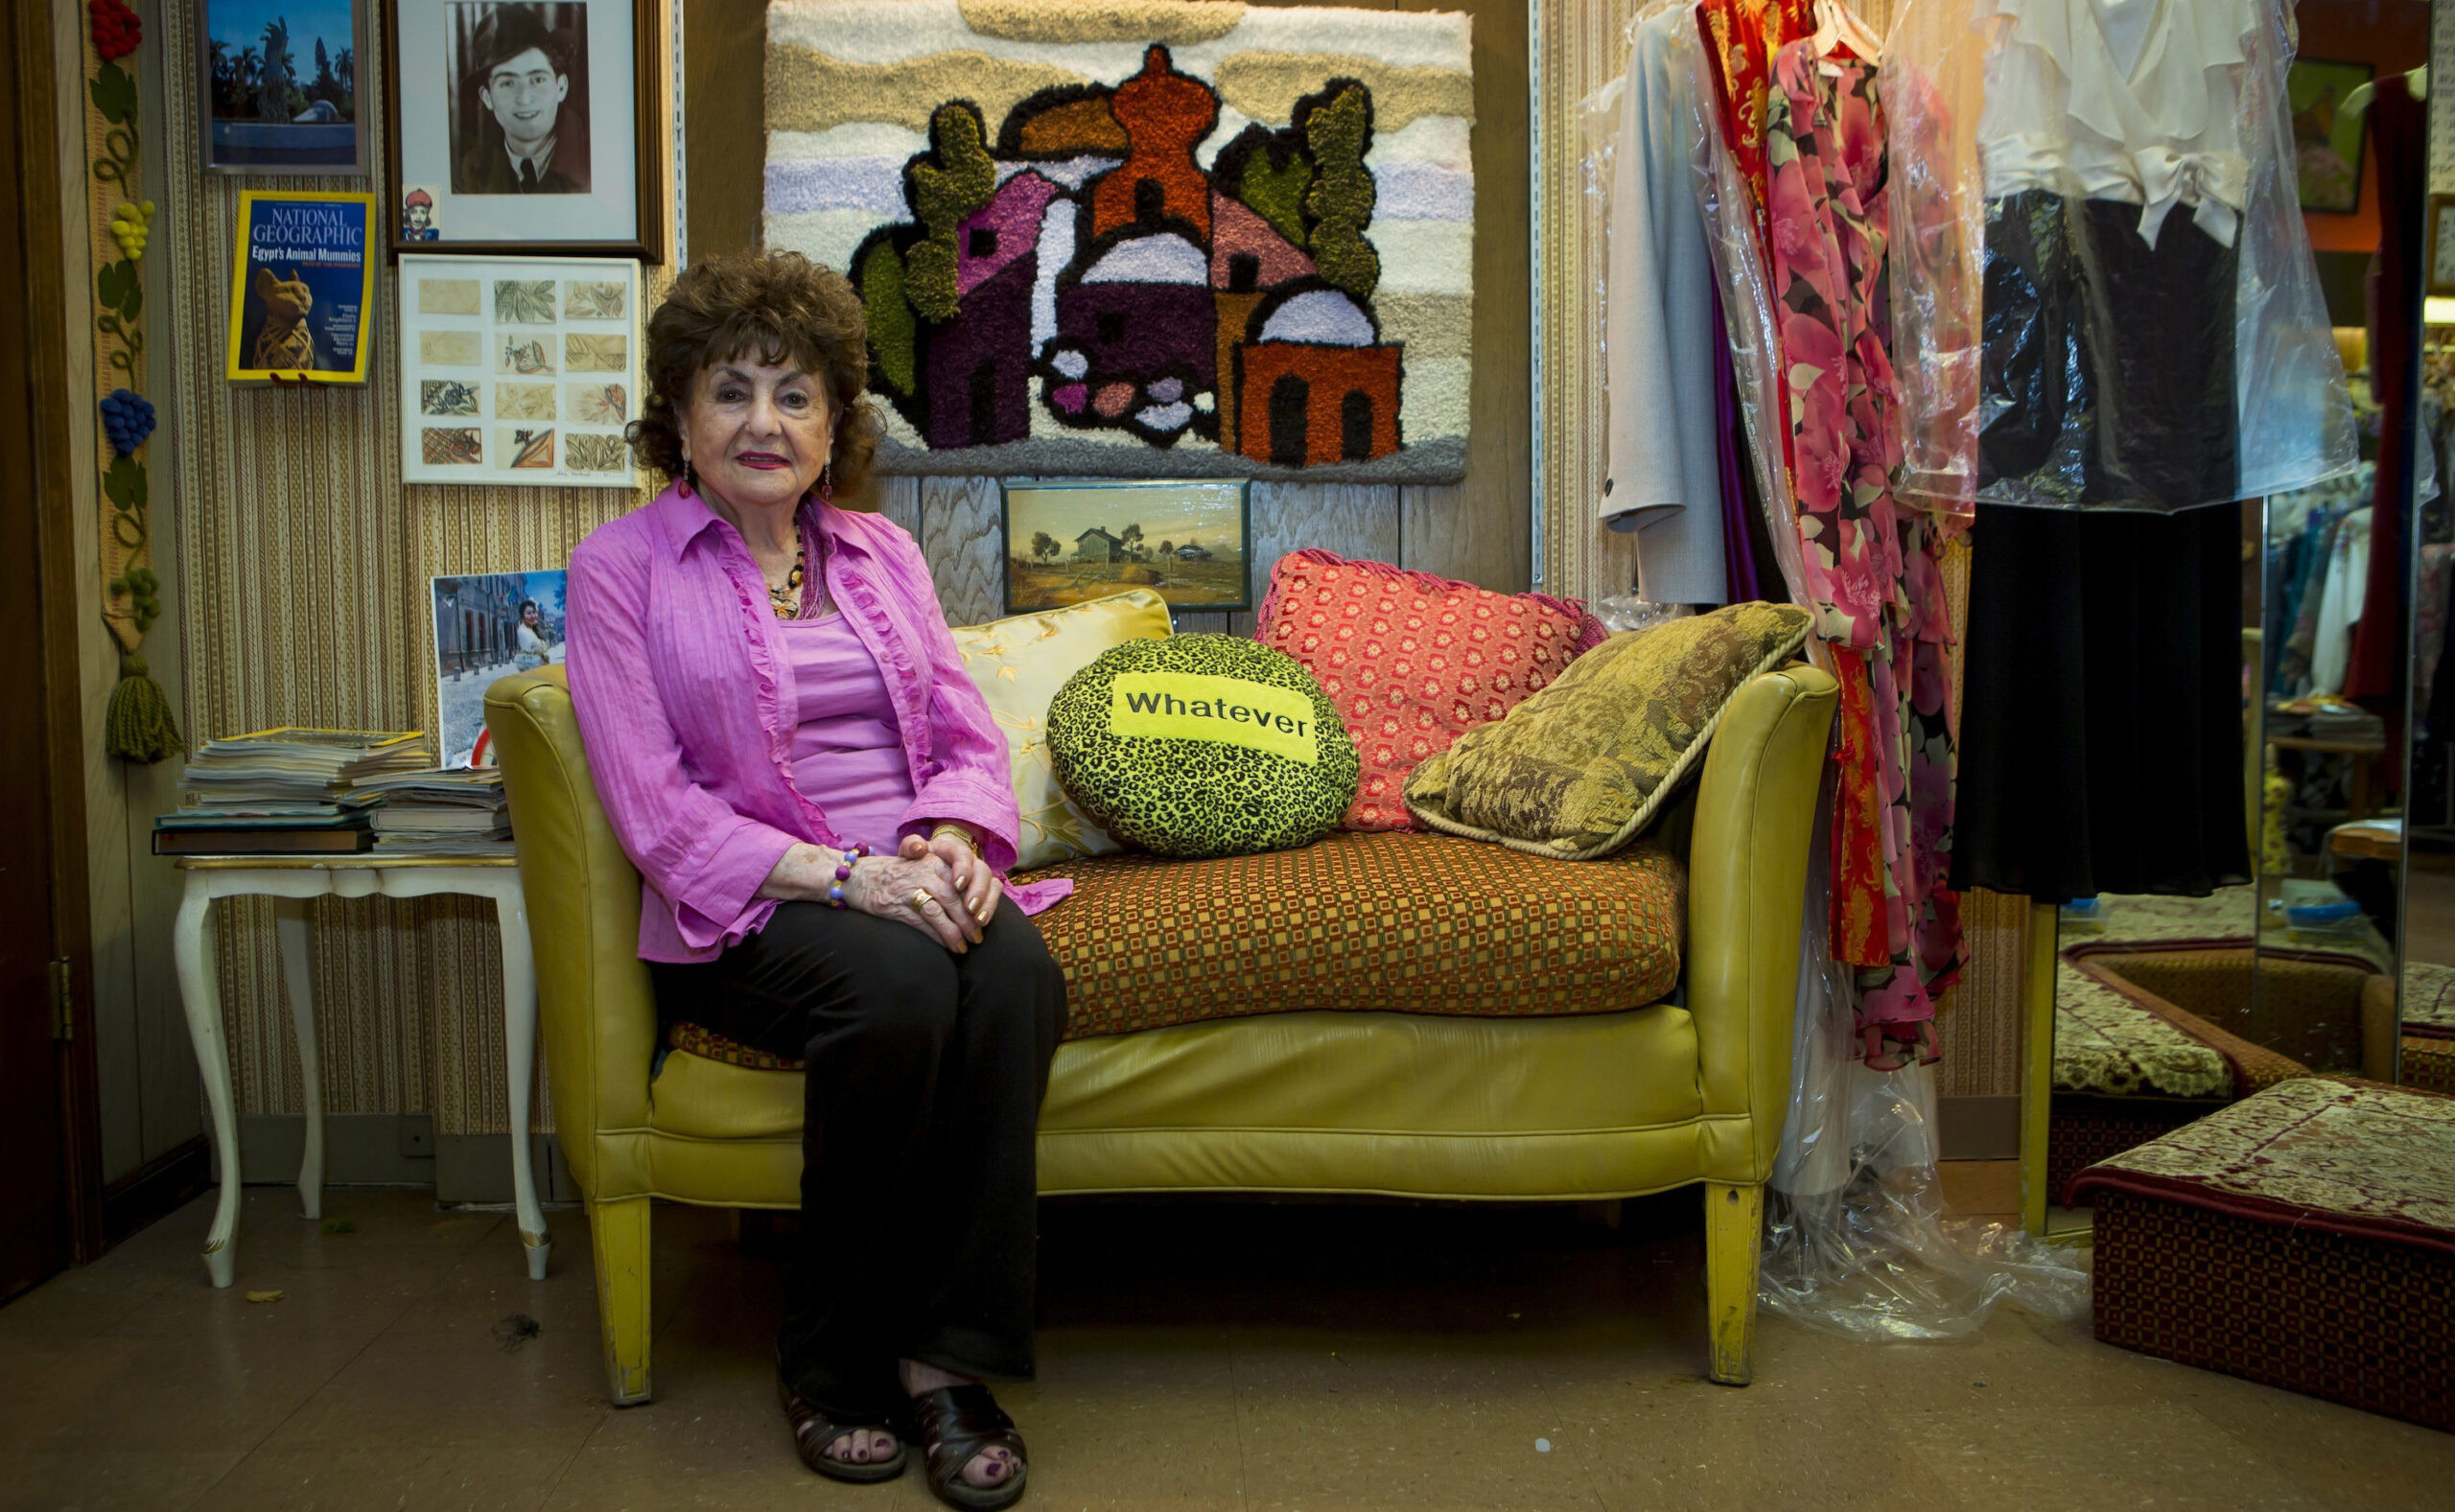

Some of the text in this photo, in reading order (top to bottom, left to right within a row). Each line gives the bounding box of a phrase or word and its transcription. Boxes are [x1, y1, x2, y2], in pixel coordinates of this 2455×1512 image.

[272, 208, 347, 226] NATIONAL
[253, 224, 362, 245] GEOGRAPHIC
[252, 245, 362, 263] Egypt's Animal Mummies
[1126, 691, 1308, 737] Whatever
